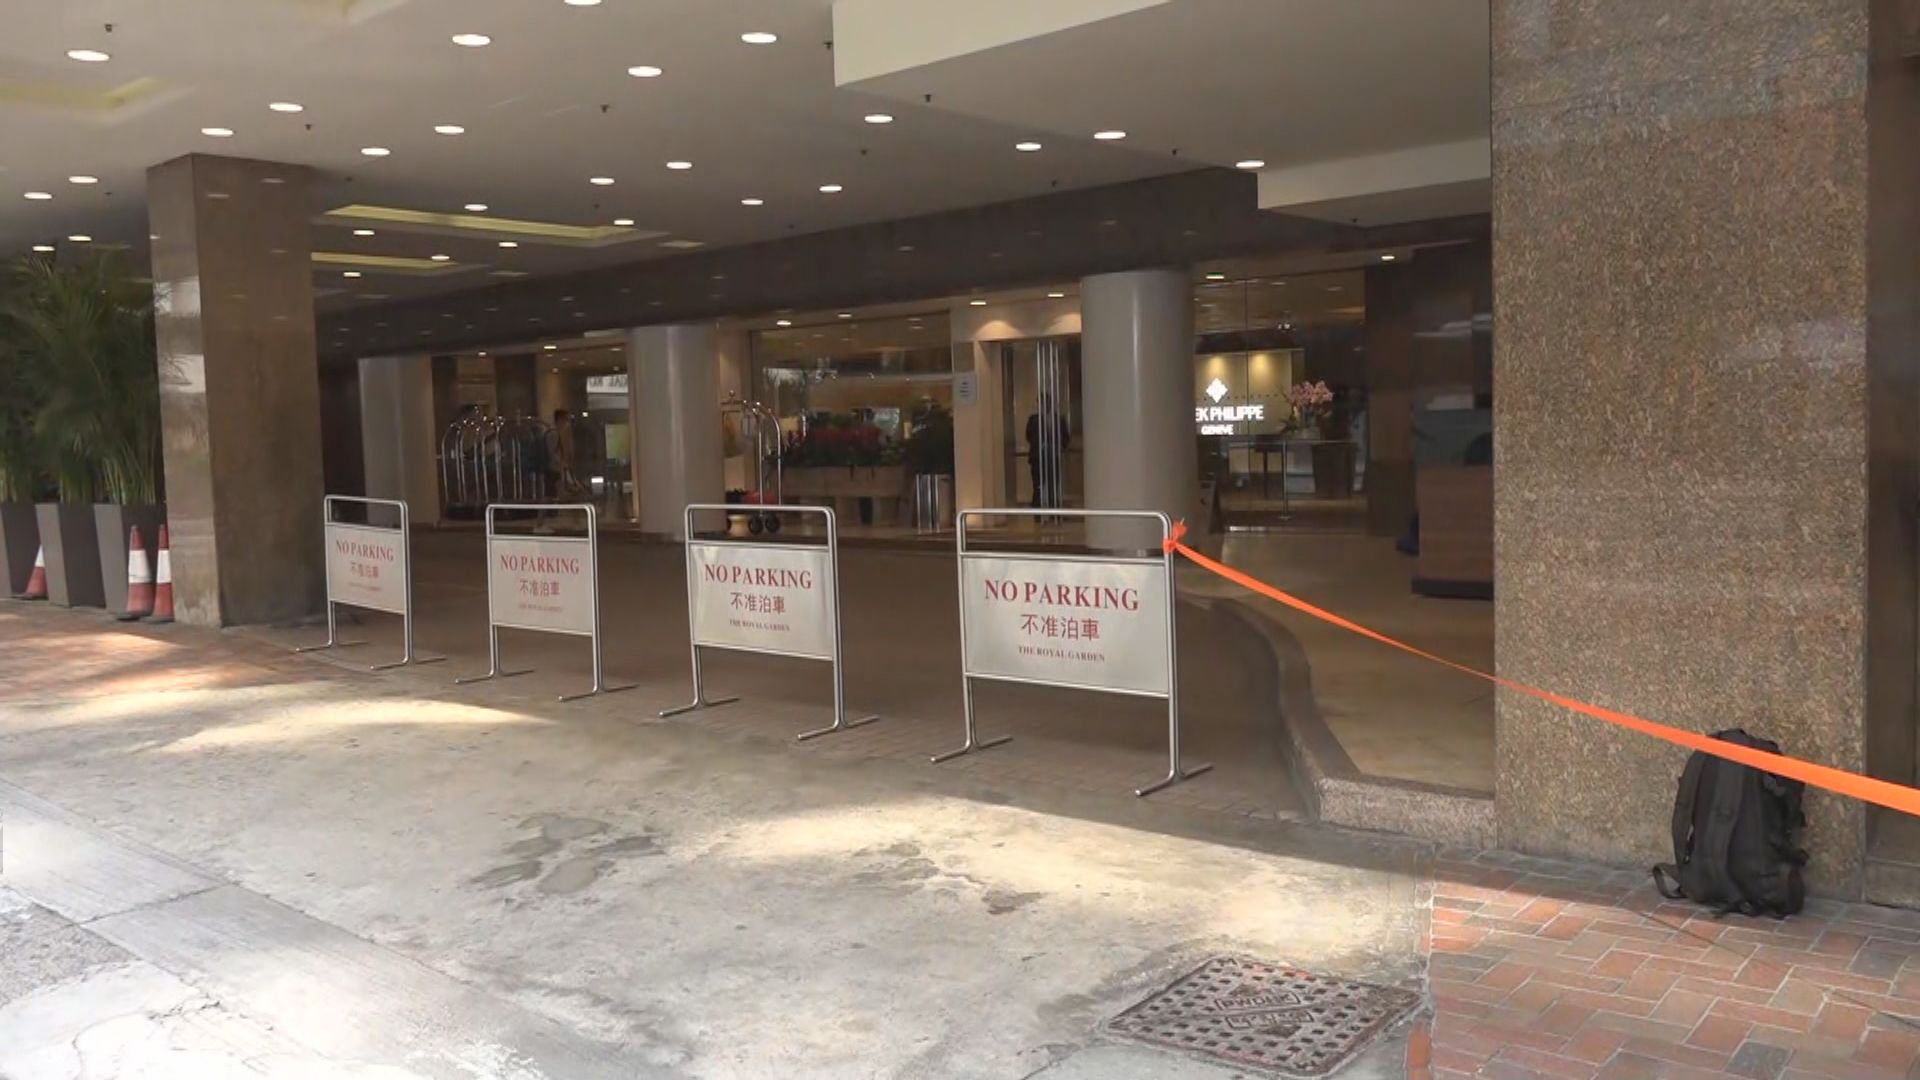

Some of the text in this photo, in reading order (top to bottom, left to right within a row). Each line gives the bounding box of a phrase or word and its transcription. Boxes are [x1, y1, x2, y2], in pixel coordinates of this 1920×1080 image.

[1210, 404, 1264, 422] PHILIPPE
[335, 539, 394, 561] NO PARKING
[500, 553, 579, 575] NO PARKING
[704, 563, 812, 590] NO PARKING
[730, 591, 786, 614] 不准泊車
[984, 579, 1139, 612] NO PARKING
[1020, 613, 1100, 641] 不准泊車
[1018, 645, 1105, 662] THE ROYAL GARDEN
